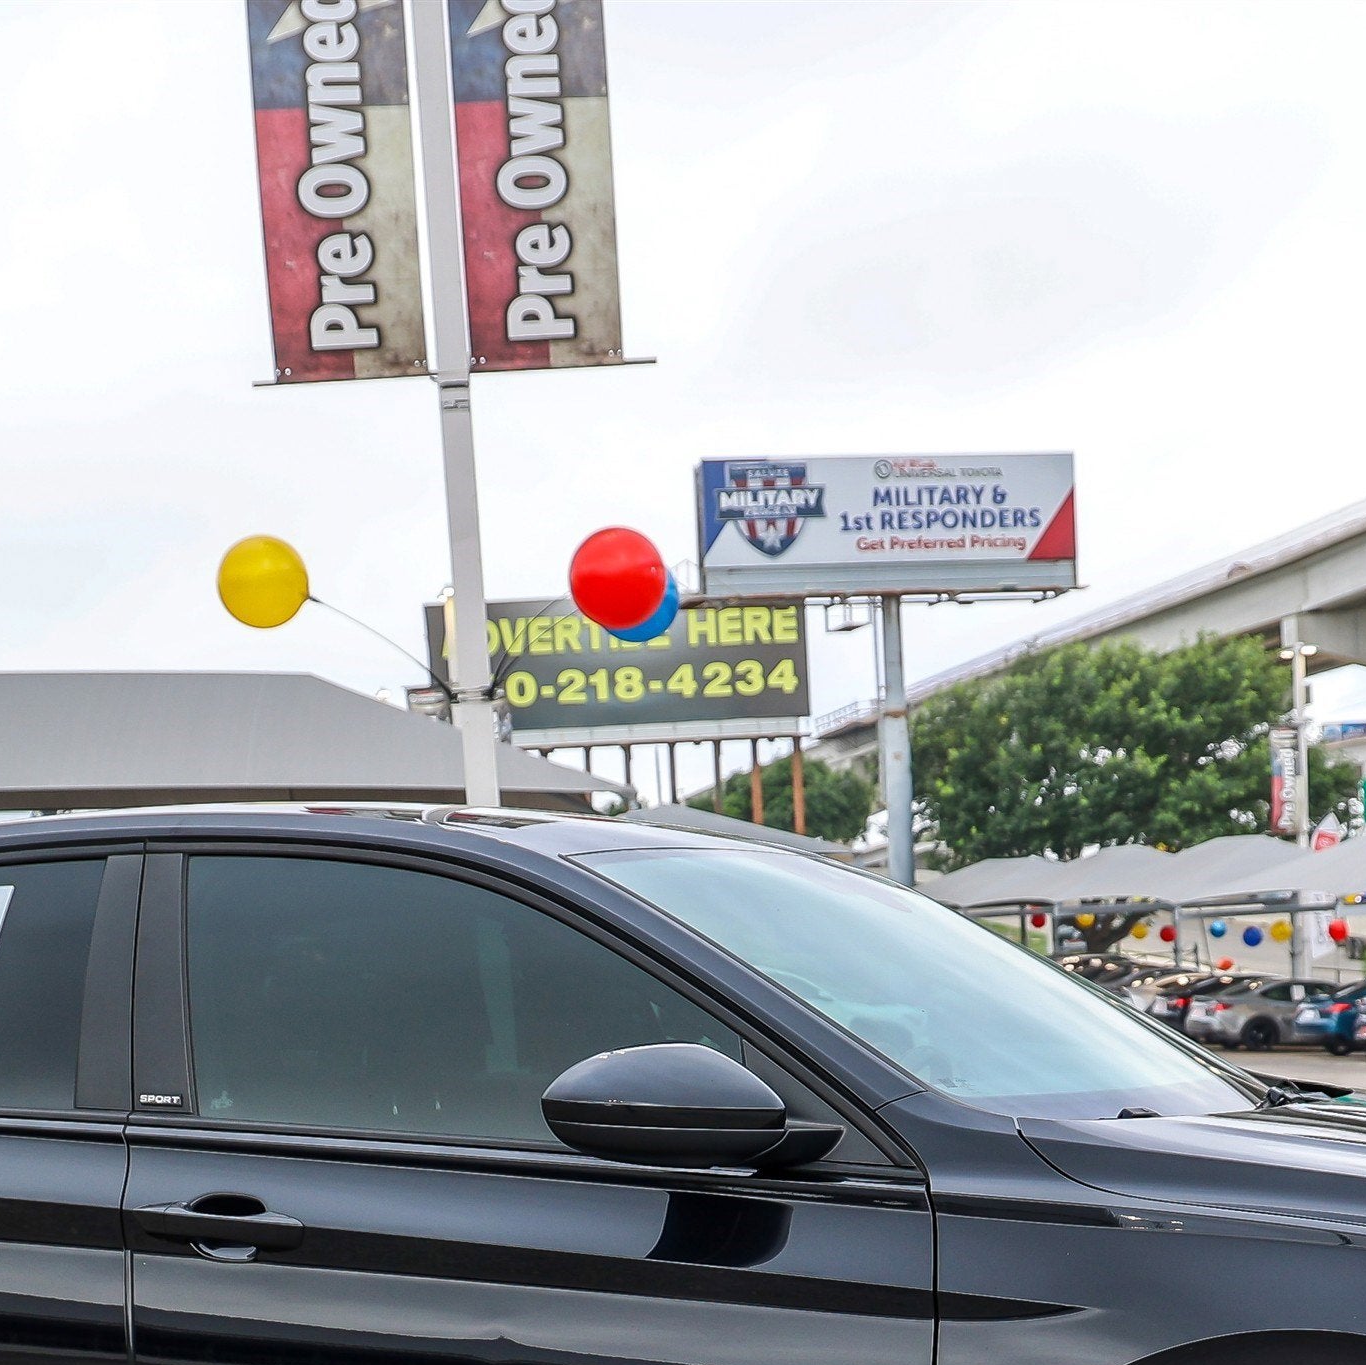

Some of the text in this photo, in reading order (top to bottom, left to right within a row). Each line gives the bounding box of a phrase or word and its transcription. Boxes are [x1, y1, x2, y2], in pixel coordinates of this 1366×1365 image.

[309, 233, 380, 351] Pre
[506, 224, 576, 342] Pre
[719, 488, 820, 510] MILITARY
[873, 484, 1007, 506] MILITARY &
[840, 507, 1042, 531] 1st RESPONDERS
[857, 533, 1026, 551] Get Preferred Pricing
[688, 606, 799, 648] HERE
[139, 1094, 181, 1104] SPORT
